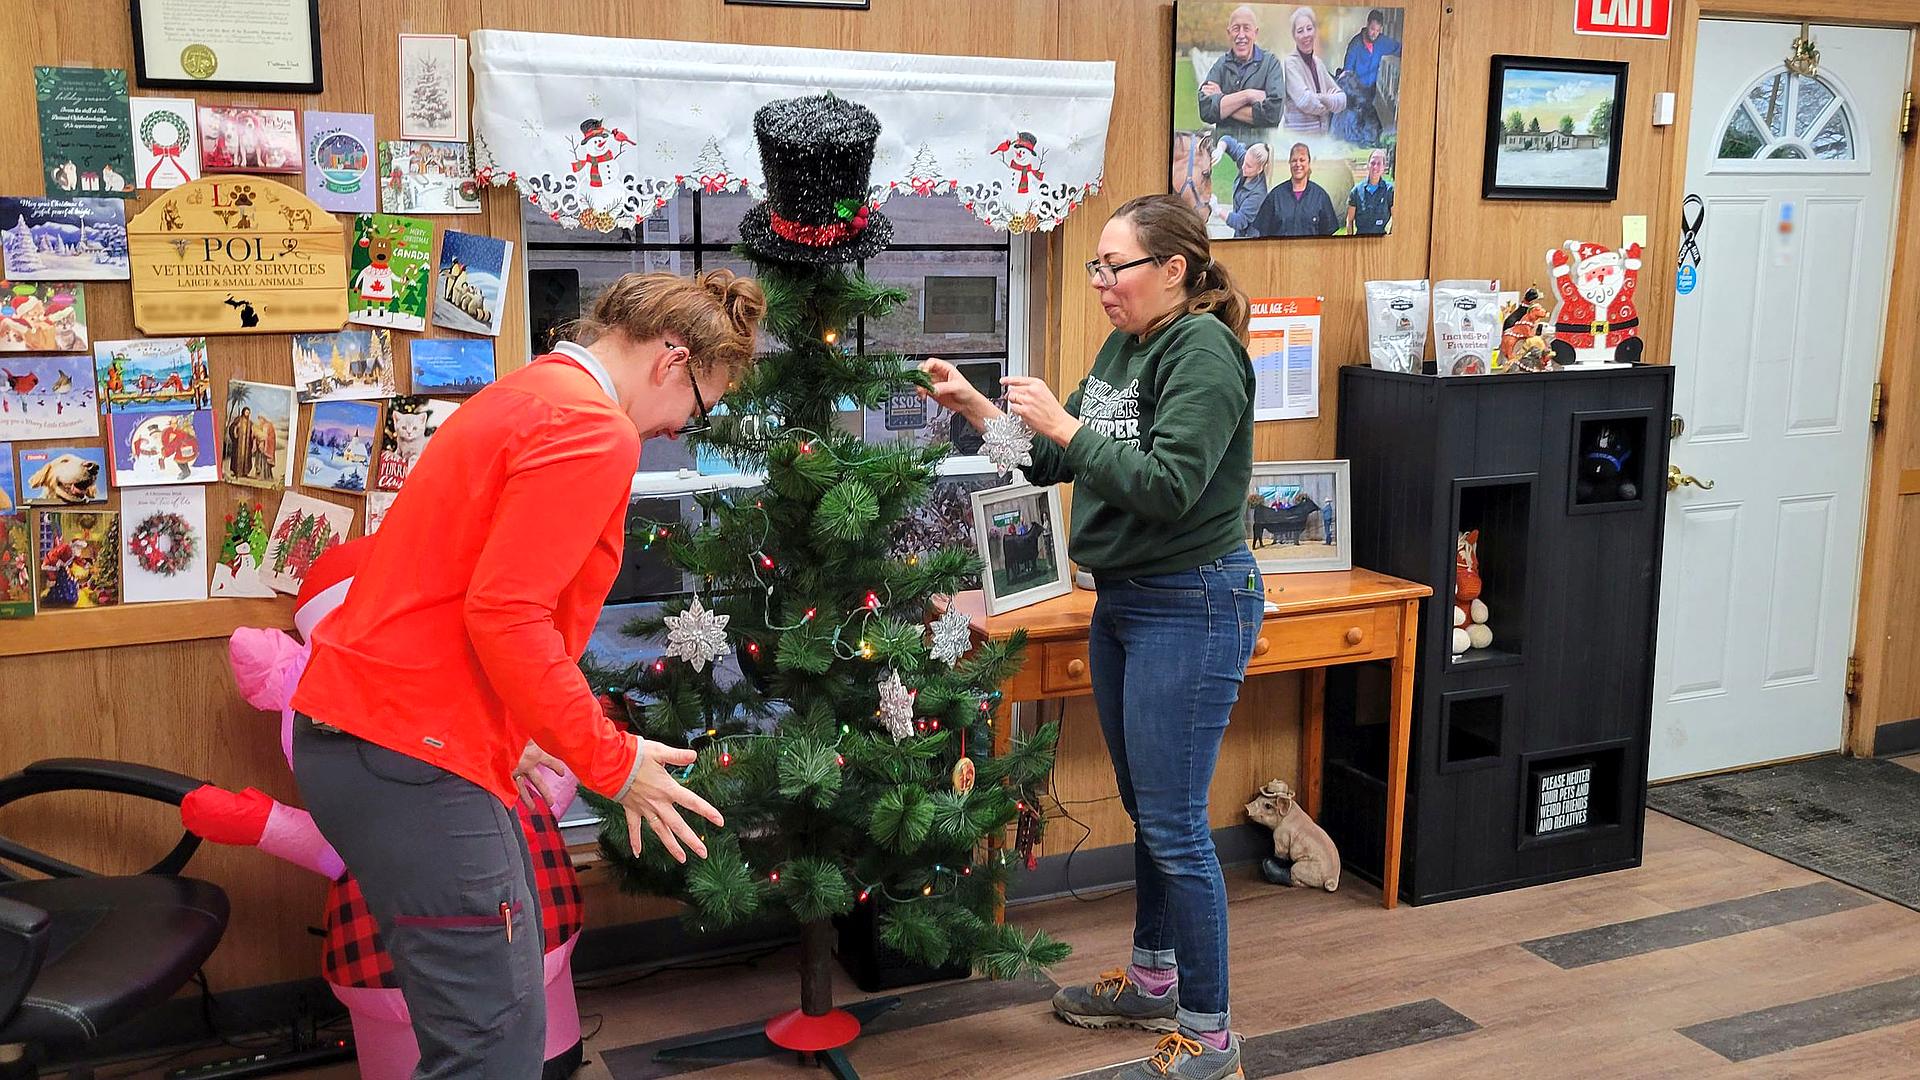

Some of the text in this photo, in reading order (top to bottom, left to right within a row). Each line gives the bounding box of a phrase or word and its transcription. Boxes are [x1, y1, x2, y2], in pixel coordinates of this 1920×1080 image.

[202, 236, 275, 262] POL
[392, 247, 430, 261] CANADA
[152, 263, 326, 277] VETERINARY SERVICES
[177, 277, 304, 288] LARGE & SMALL ANIMALS
[1270, 302, 1283, 314] AGE
[1541, 768, 1591, 791] PLEASE NEUTER
[1541, 782, 1590, 805] YOUR PETS AND
[1540, 796, 1589, 819] WEIRD FRIENDS
[1538, 810, 1587, 833] AND RELATIVES
